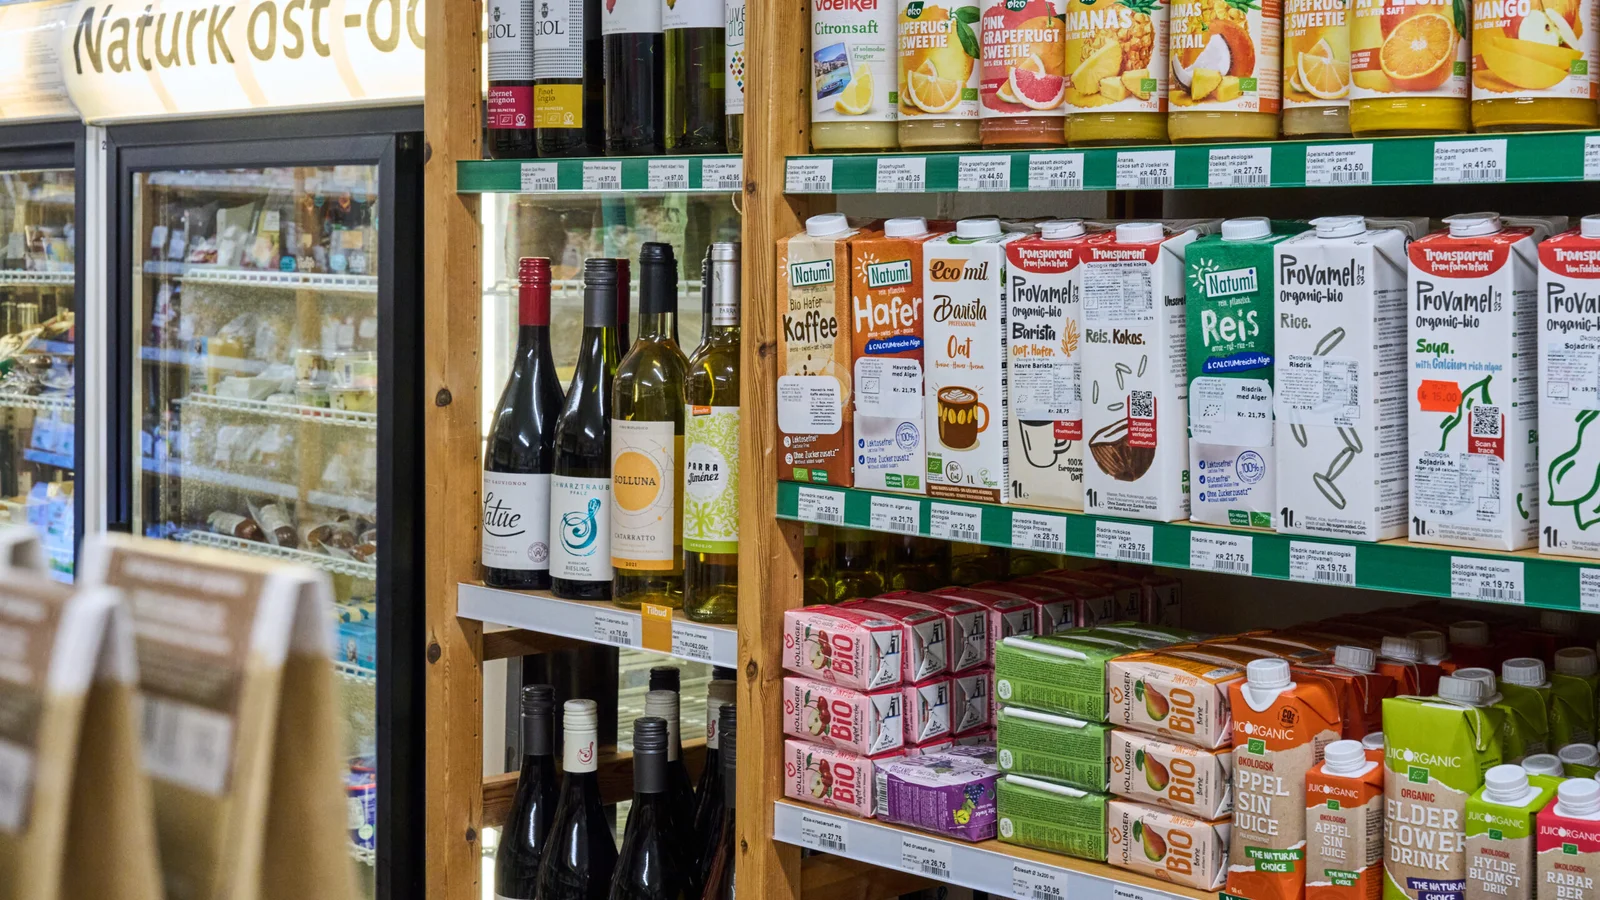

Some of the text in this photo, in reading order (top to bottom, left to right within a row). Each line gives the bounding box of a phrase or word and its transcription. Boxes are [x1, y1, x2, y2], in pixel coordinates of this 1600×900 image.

[1386, 6, 1405, 16] SAFT
[1474, 0, 1531, 20] MANGO
[535, 20, 565, 37] GIOL
[815, 20, 879, 35] Citronsaft
[983, 16, 1005, 30] PINK
[1291, 12, 1346, 29] SWEETIE
[1495, 19, 1511, 28] SAFT
[488, 23, 516, 39] GIOL
[983, 29, 1060, 45] GRAPEFRUGT
[902, 35, 949, 50] SWEETIE
[983, 45, 1030, 59] SWEETIE
[1017, 247, 1074, 264] Transparent
[1091, 248, 1147, 265] Transparent
[1423, 248, 1494, 264] Transparent
[795, 261, 831, 283] Natumi
[871, 261, 910, 284] Natumi
[1209, 269, 1256, 294] Natumi
[789, 296, 824, 311] Bio Hafer
[933, 294, 987, 323] Barista
[854, 294, 922, 334] Hafer
[1280, 312, 1312, 330] Rice.
[782, 310, 838, 344] Kaffee
[1012, 322, 1056, 341] Barista
[1201, 309, 1259, 347] Reis
[1085, 328, 1147, 346] Reis. Kokos.
[947, 334, 973, 359] Oat
[1415, 338, 1454, 358] Soya.
[892, 363, 917, 371] Havredrik
[1014, 362, 1053, 370] Havre Barista
[1415, 360, 1431, 369] with
[1468, 362, 1483, 371] rich
[903, 386, 917, 394] 21,75
[1236, 393, 1268, 402] med Alger
[1241, 386, 1263, 394] Risdrik
[1474, 440, 1491, 448] Scan
[1477, 447, 1495, 455] trace
[688, 461, 719, 472] PARRA
[1418, 459, 1446, 468] Sojadrik
[614, 475, 657, 486] SOLLUNA
[688, 472, 720, 486] Jiménez
[614, 532, 657, 542] CATARRATTO
[565, 565, 590, 573] RIESLING
[1451, 561, 1473, 571] Sojadrik
[1488, 565, 1510, 574] calcium
[1451, 569, 1478, 579] økologisk
[646, 605, 668, 618] Tilbud
[832, 633, 855, 677] BiO
[1168, 687, 1196, 735] BiO
[831, 700, 854, 743] BiO
[1238, 756, 1275, 772] ØKOLOGISK
[833, 762, 856, 806] BiO
[1168, 757, 1197, 806] BiO
[1401, 787, 1436, 803] ORGANIC
[1238, 791, 1272, 816] SIN
[1319, 814, 1347, 824] ØKOLOGISK
[1387, 798, 1459, 831] ELDER
[1234, 811, 1280, 836] JUICE
[1314, 822, 1351, 838] APPEL
[1323, 835, 1344, 849] SIN
[1166, 828, 1193, 876] BiO
[1249, 849, 1300, 861] THE NATURAL
[1319, 846, 1347, 859] JUICE
[1390, 845, 1450, 871] DRINK
[1480, 847, 1510, 859] ØKOLOGISK
[1260, 861, 1288, 872] CHOICE
[1474, 856, 1517, 875] HYLDE
[1553, 861, 1587, 874] ØKOLOGISK
[1412, 880, 1428, 890] THE
[1469, 867, 1521, 888] BLOMST
[1546, 871, 1594, 891] RABAR
[1482, 882, 1509, 896] DRIK
[1556, 886, 1584, 900] BER
